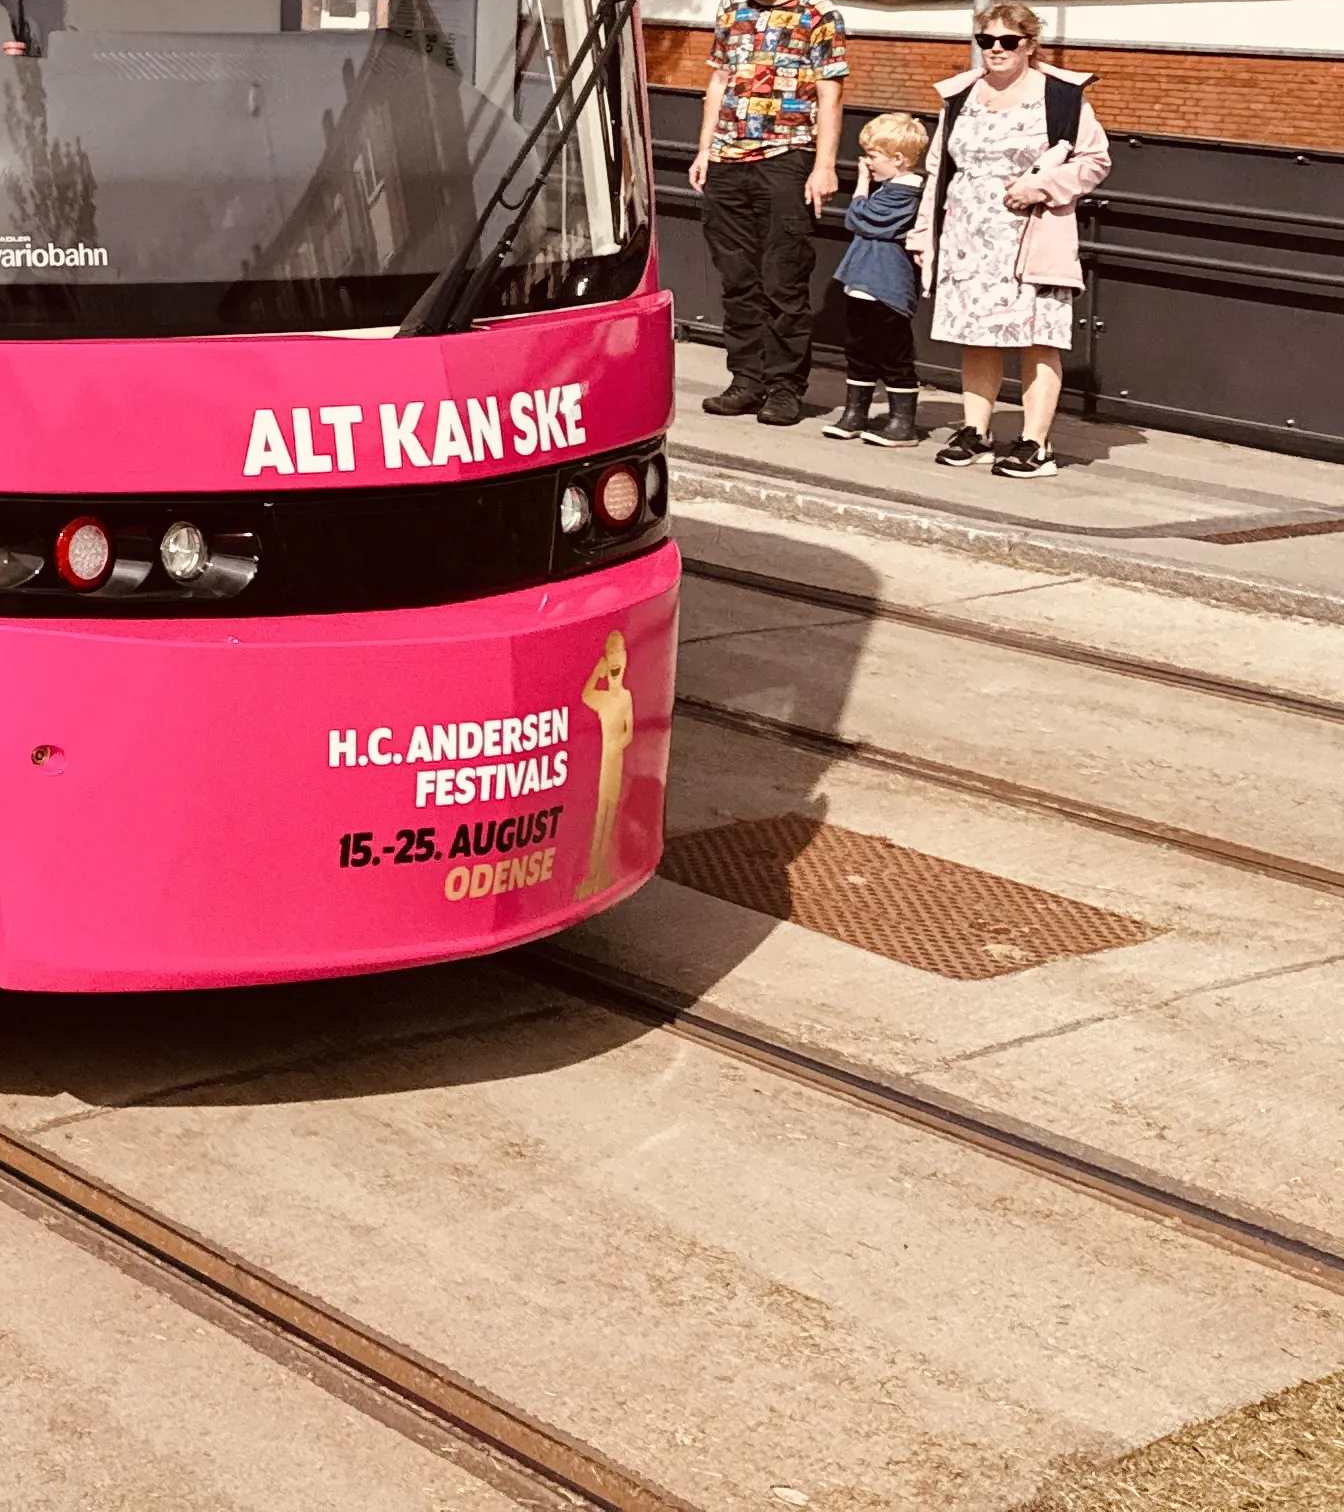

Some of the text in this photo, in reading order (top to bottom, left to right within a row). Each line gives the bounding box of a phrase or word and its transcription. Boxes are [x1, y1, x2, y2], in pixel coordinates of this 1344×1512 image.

[243, 382, 587, 476] ALT KAN SKE
[329, 706, 569, 767] H.C. ANDERSEN
[415, 750, 569, 808] FESTIVALS
[339, 805, 564, 868] 15.-25. AUGUST
[444, 847, 556, 902] ODENSE
